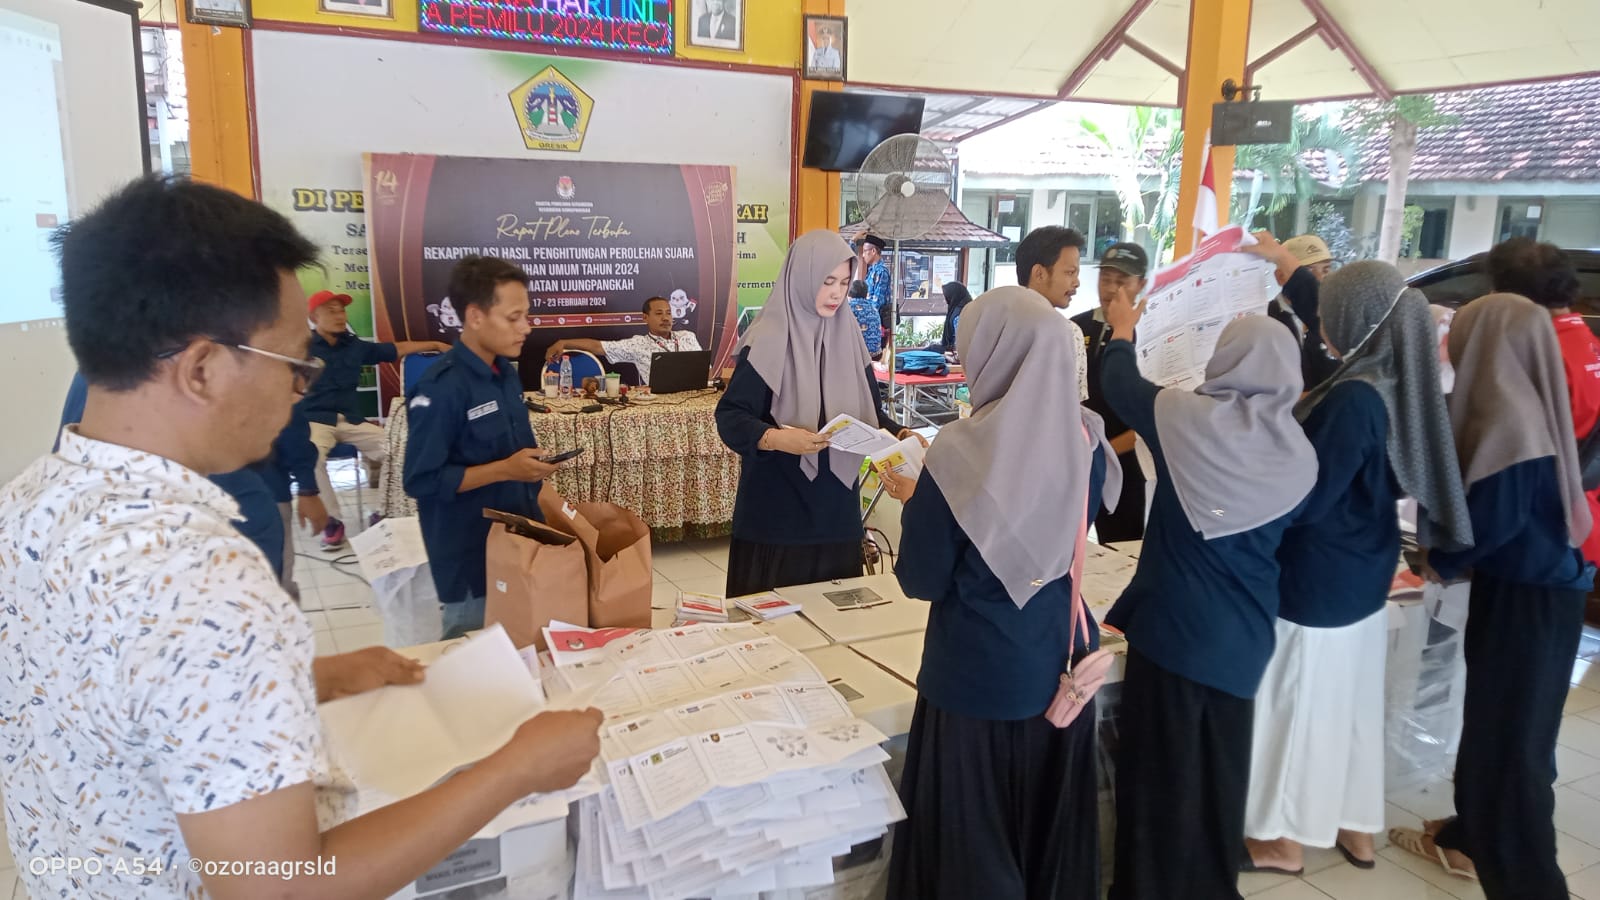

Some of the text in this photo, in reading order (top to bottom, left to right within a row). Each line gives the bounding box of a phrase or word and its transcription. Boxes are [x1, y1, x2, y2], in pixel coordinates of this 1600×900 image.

[451, 4, 544, 35] PEMILU
[552, 17, 603, 41] 2024
[293, 188, 328, 211] DI
[496, 213, 552, 241] Rapat
[581, 215, 632, 240] Terbuka
[501, 247, 531, 260] HASIL
[533, 247, 608, 260] PENGHITUNGAN
[609, 247, 663, 260] PEROLEHAN
[665, 247, 695, 259] SUARA
[548, 263, 580, 276] UMUM
[581, 263, 613, 276] TAHUN
[614, 263, 640, 275] 2024
[560, 278, 635, 292] UJUNGPANGKAH
[532, 298, 541, 308] 17
[547, 297, 557, 307] 23
[557, 297, 589, 308] FEBRUARI
[589, 297, 607, 307] 2024
